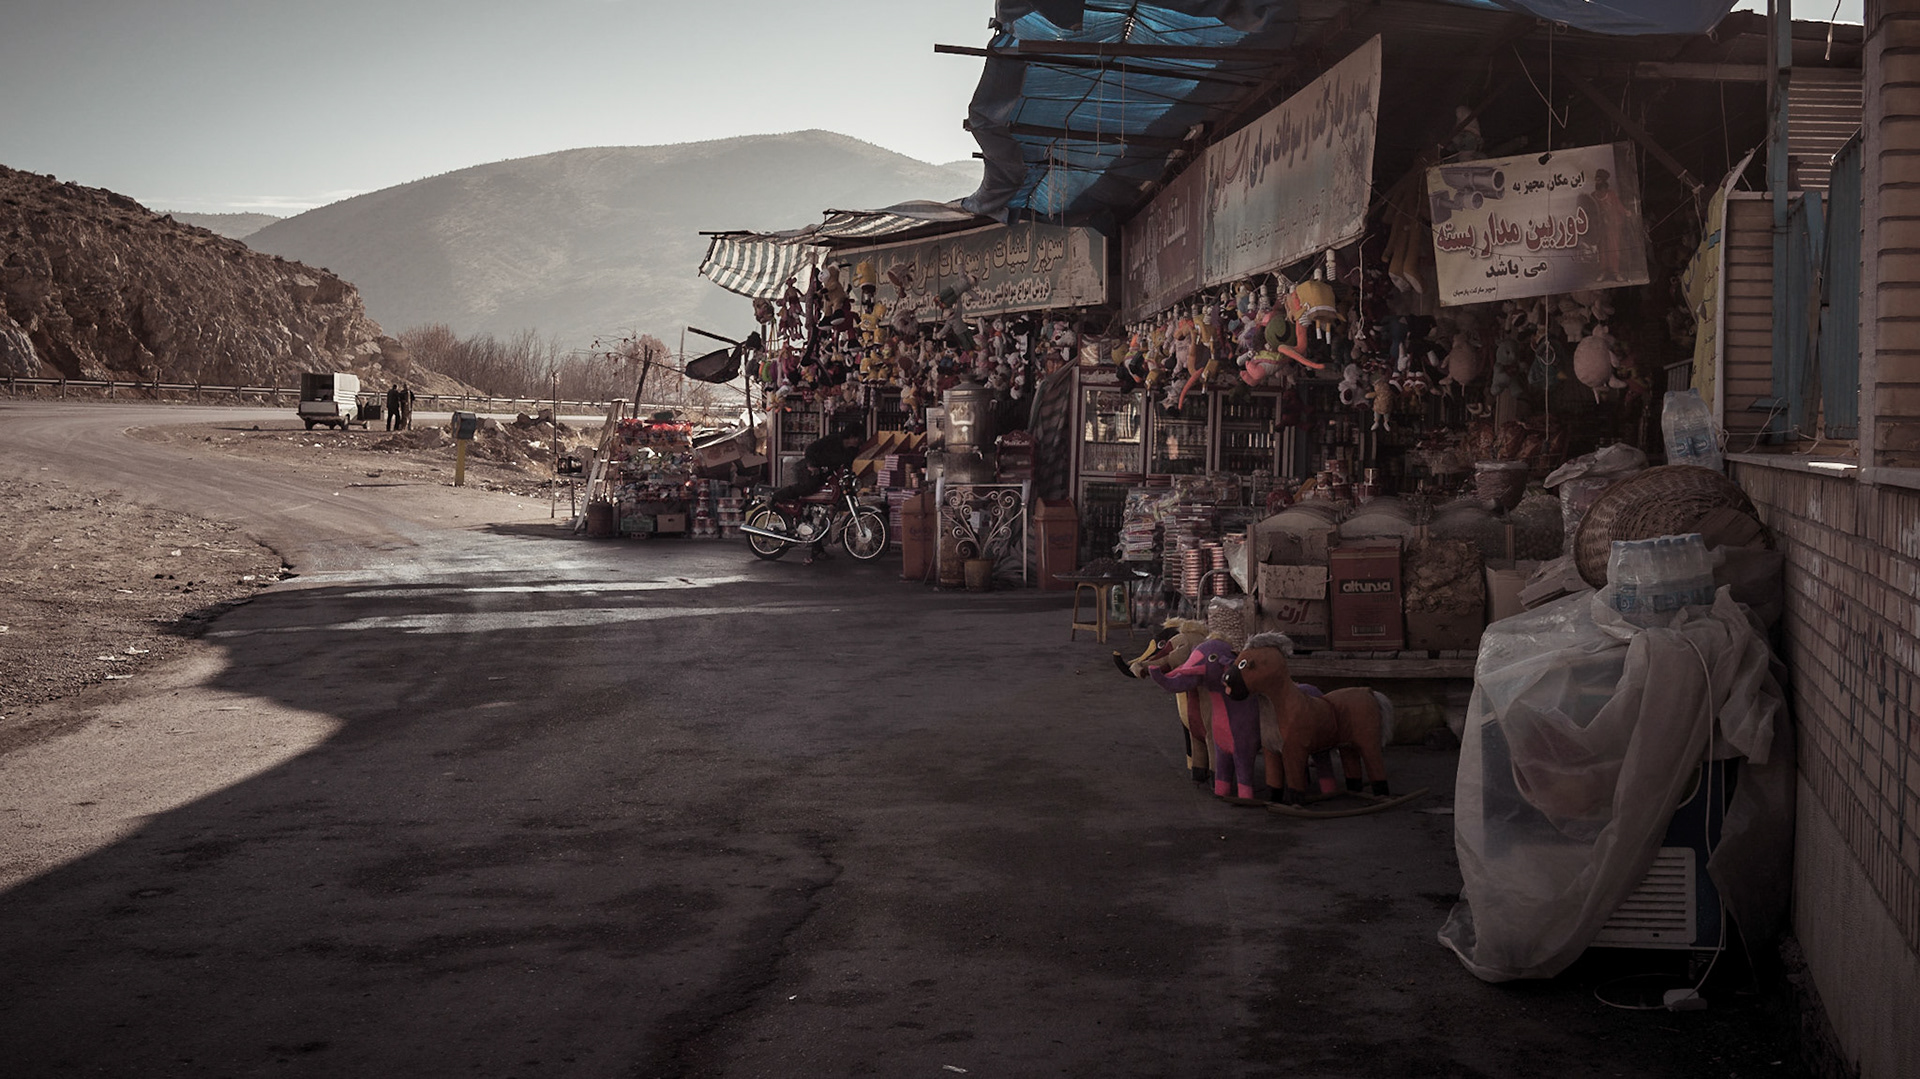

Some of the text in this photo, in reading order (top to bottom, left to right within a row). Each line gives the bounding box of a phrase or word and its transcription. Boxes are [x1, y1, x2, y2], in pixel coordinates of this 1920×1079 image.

[1512, 170, 1585, 195] این مکان مجهز به
[1436, 206, 1589, 258] دوربین مدار بسته
[982, 249, 991, 280] و
[992, 228, 1031, 275] لبنیات
[1033, 236, 1064, 274] سوپر
[1485, 259, 1547, 279] می باشد
[1017, 278, 1033, 304] انواع
[1031, 277, 1051, 303] فروش
